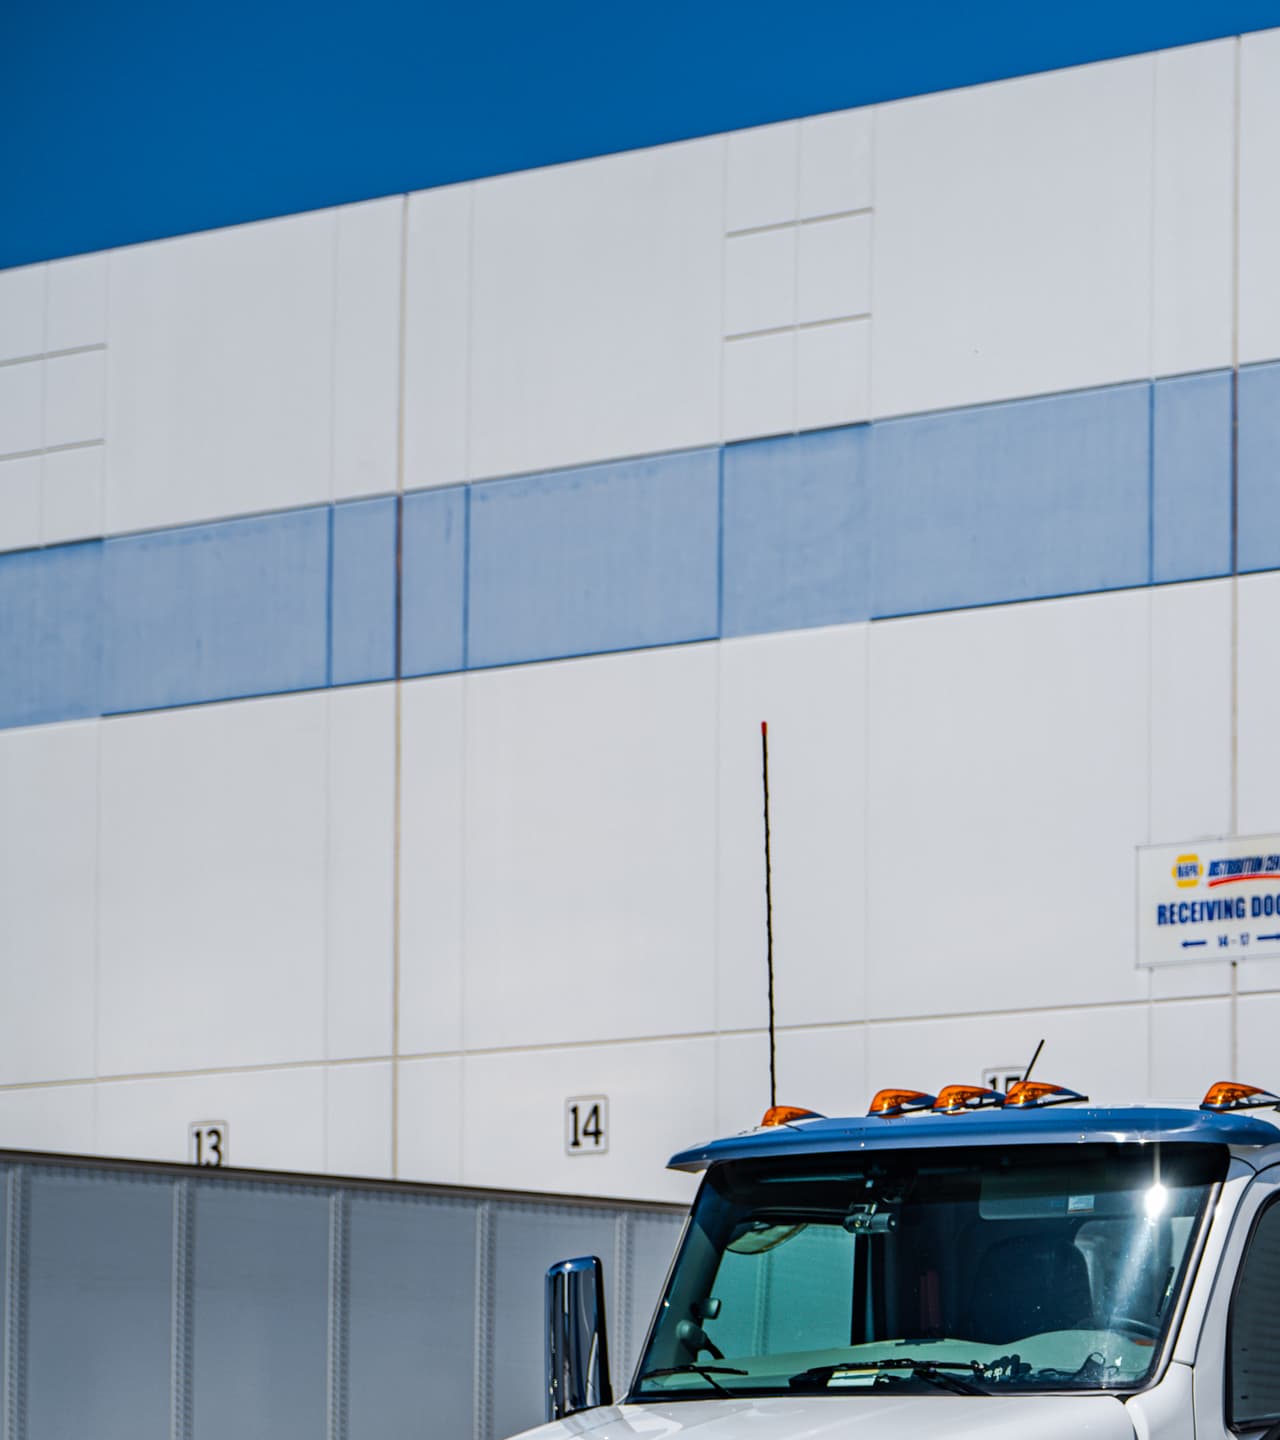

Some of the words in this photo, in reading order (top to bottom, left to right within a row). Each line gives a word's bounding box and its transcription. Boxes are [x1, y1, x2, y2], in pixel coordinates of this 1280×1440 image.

[1157, 896, 1246, 925] RECEIVING
[571, 1103, 603, 1147] 14
[195, 1129, 222, 1167] 13
